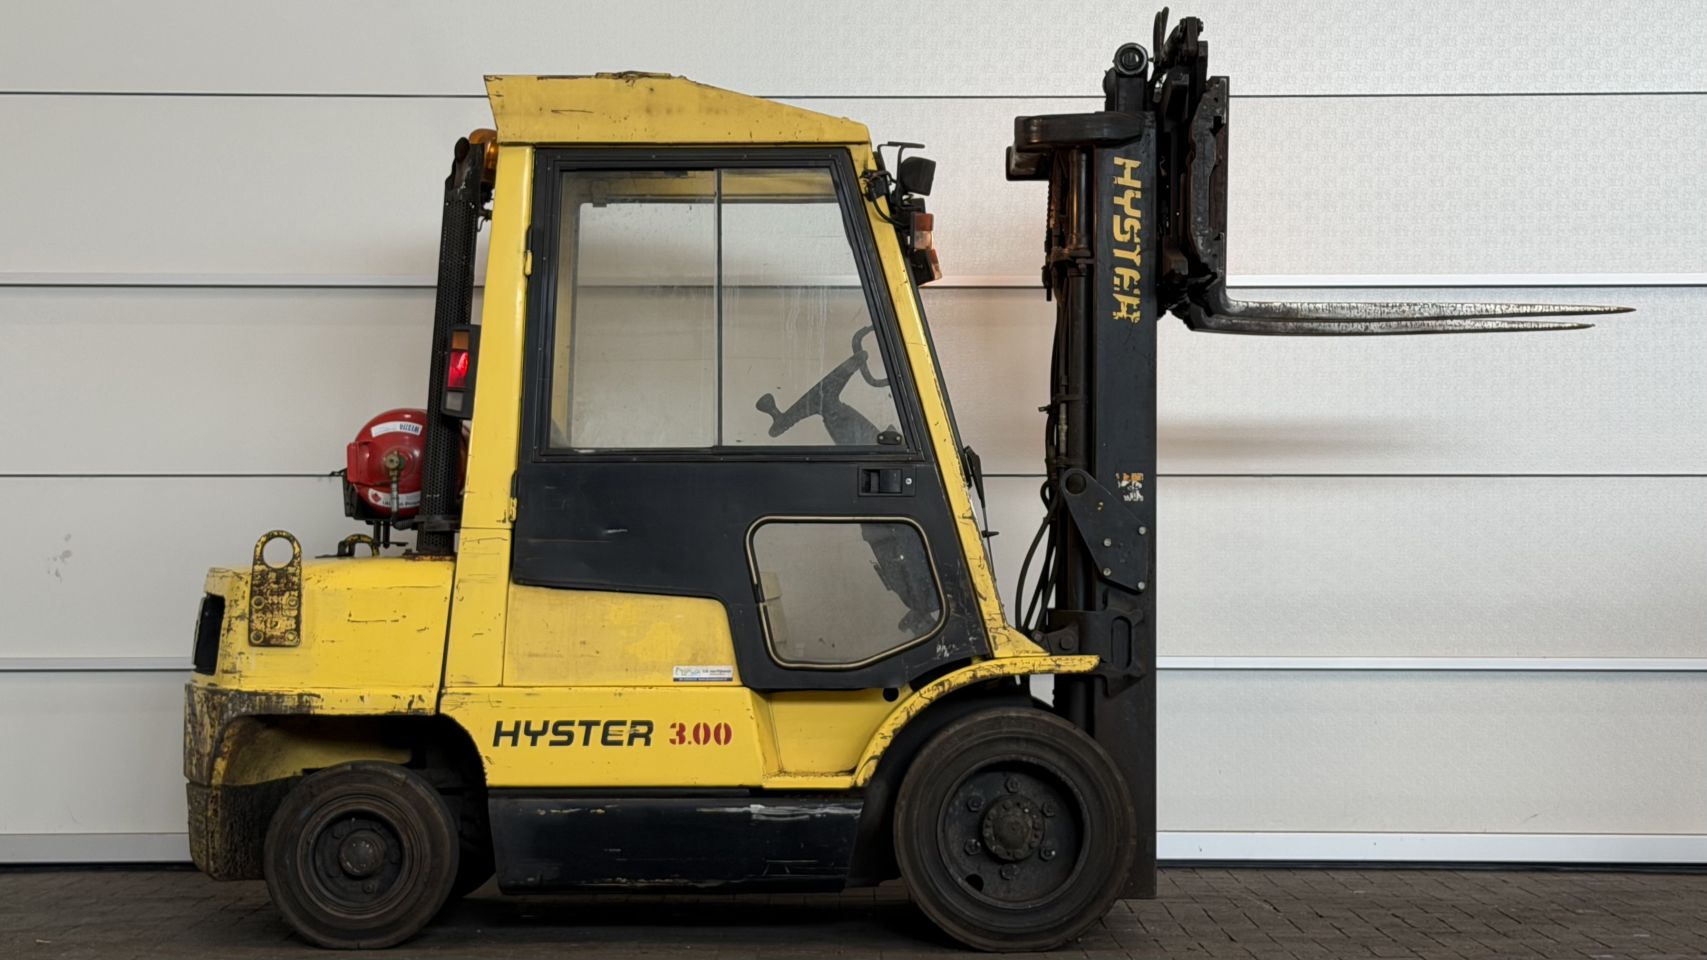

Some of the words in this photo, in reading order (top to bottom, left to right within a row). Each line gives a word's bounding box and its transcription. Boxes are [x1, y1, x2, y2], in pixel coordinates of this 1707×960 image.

[1113, 156, 1142, 324] HYSTER
[492, 720, 654, 747] HYSTER
[669, 722, 732, 745] 3.00
